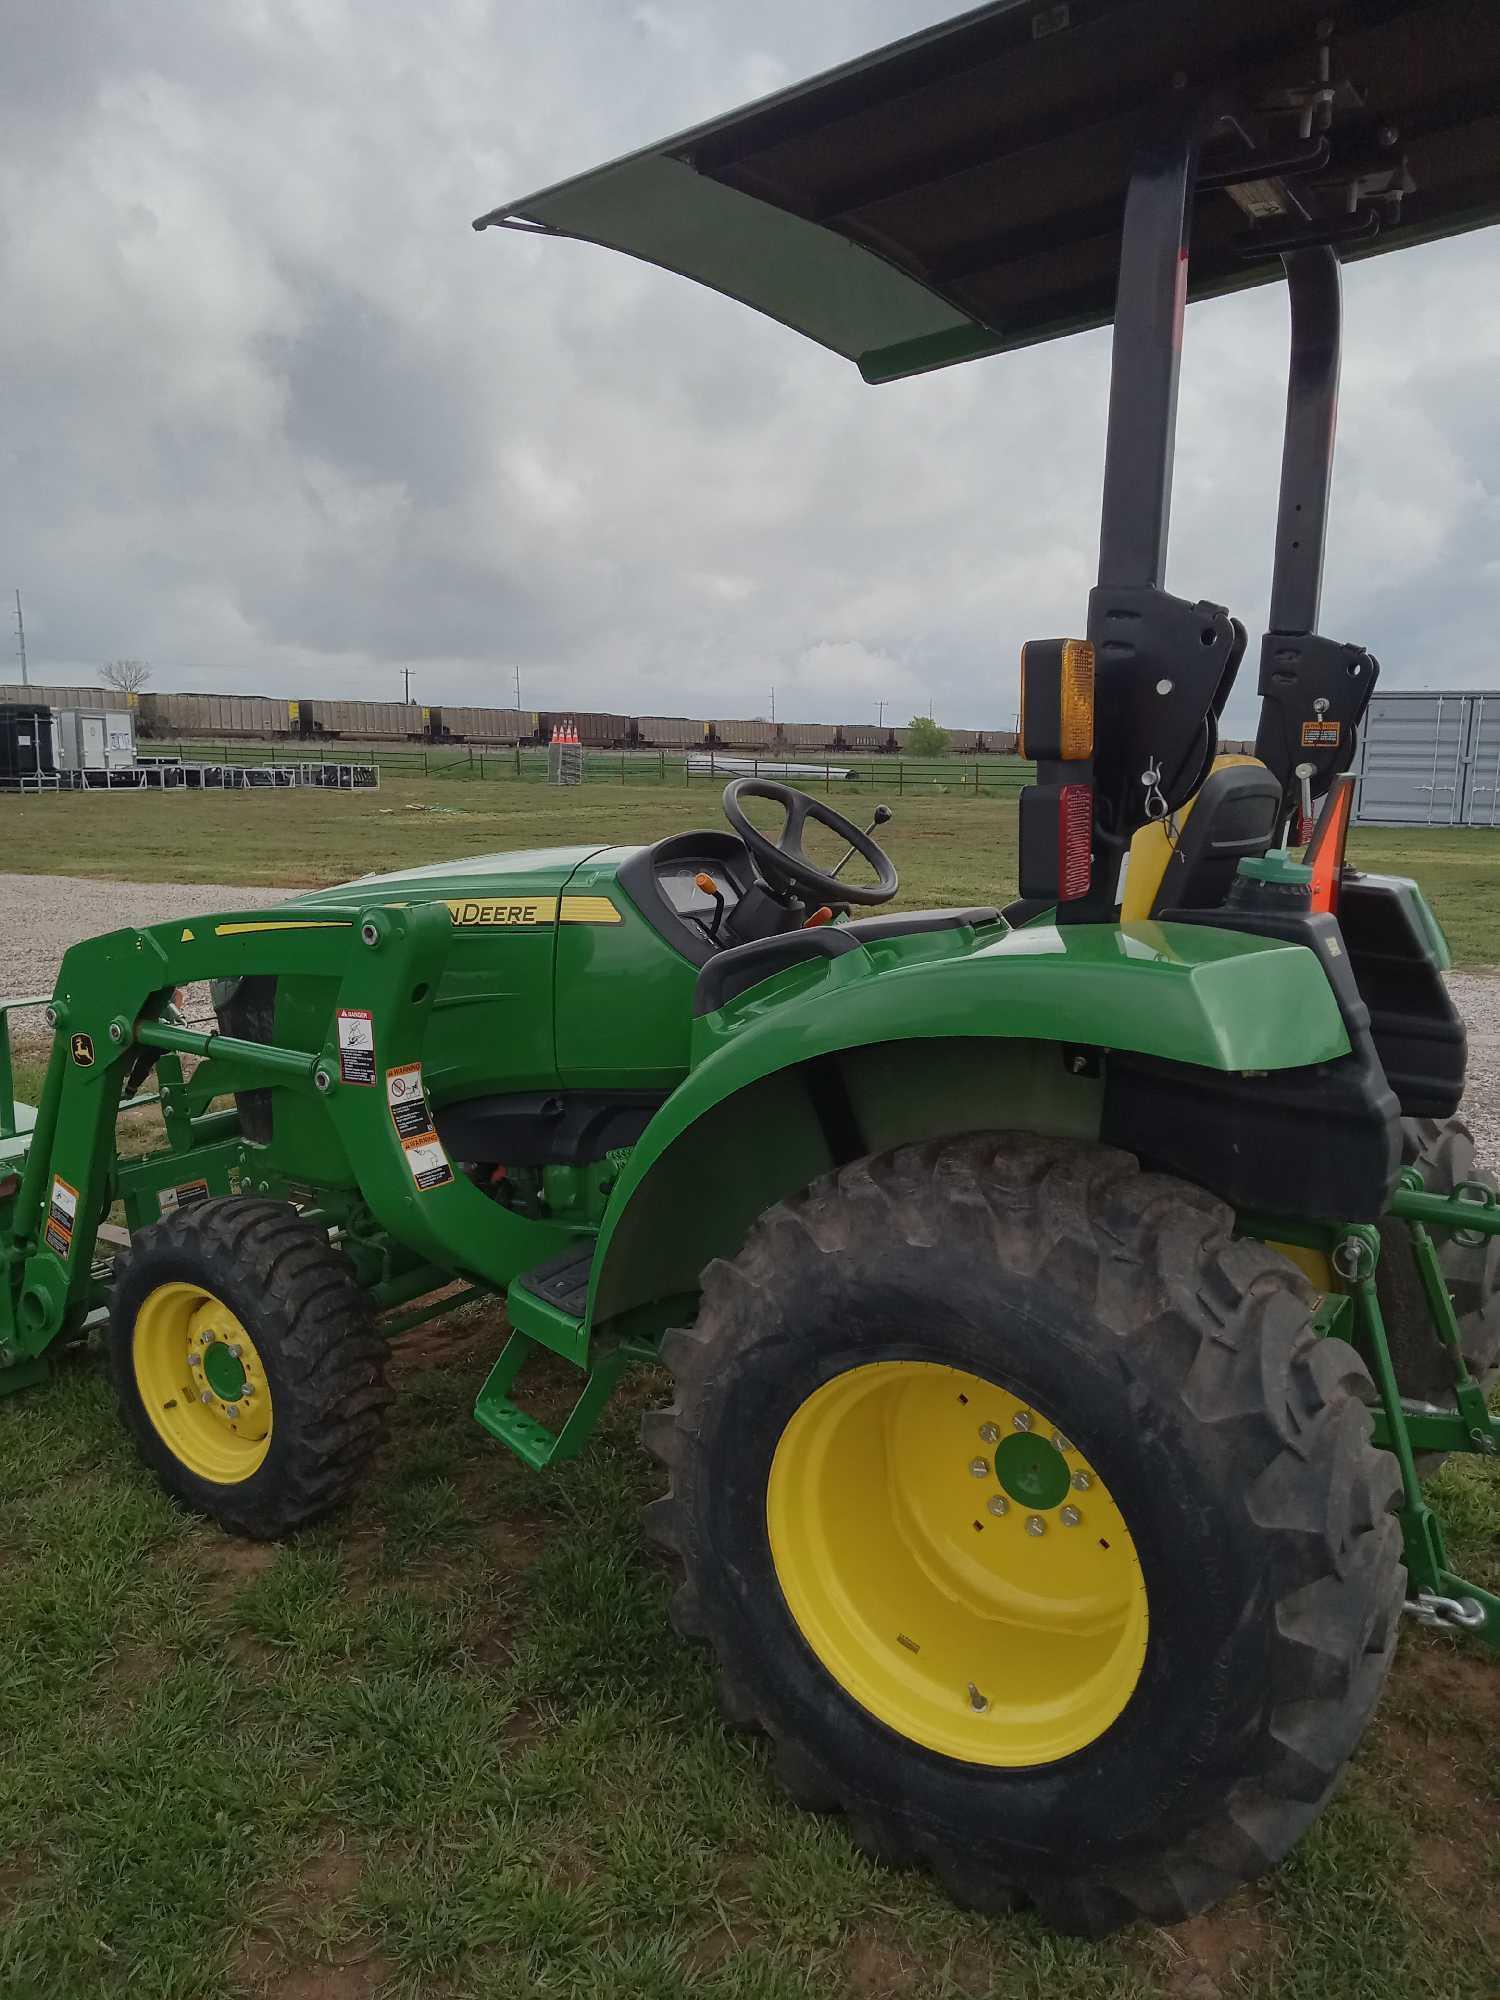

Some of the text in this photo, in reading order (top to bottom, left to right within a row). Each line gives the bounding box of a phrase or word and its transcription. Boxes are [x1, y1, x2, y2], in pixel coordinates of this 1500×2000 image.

[463, 904, 538, 922] DEERE
[393, 1063, 421, 1074] WARNING
[410, 1134, 438, 1146] WARNING
